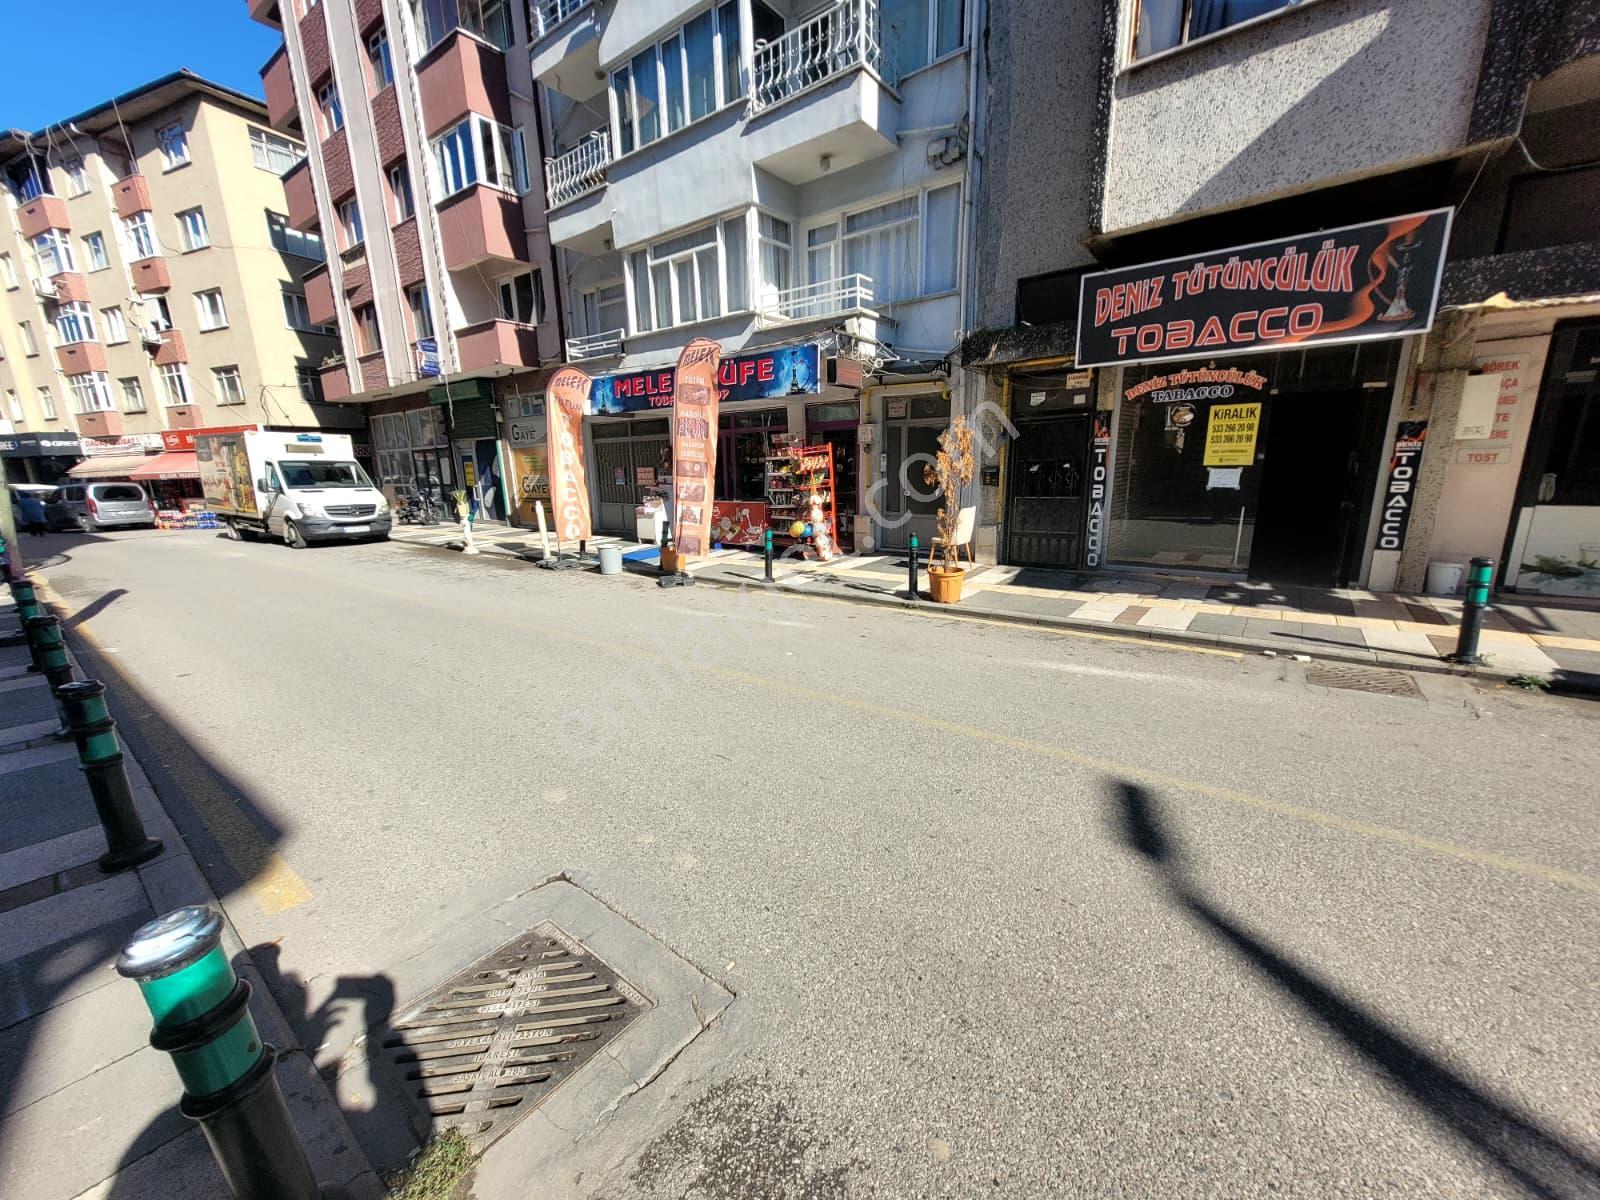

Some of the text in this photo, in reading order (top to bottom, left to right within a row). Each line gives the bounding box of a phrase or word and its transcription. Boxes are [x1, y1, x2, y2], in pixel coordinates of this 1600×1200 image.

[1172, 239, 1359, 301] TÜTÜNCÜLÜK
[1111, 303, 1324, 355] TOBACCO
[614, 358, 775, 398] MELE ÜFE
[1152, 385, 1234, 402] TABACCO
[1168, 368, 1267, 391] TÜTÜNCÜLÜK
[1211, 435, 1222, 444] 533
[1212, 424, 1224, 433] 533
[1466, 452, 1499, 464] TOST
[1087, 448, 1107, 566] TOBACCO
[1380, 451, 1416, 549] TOBACCO
